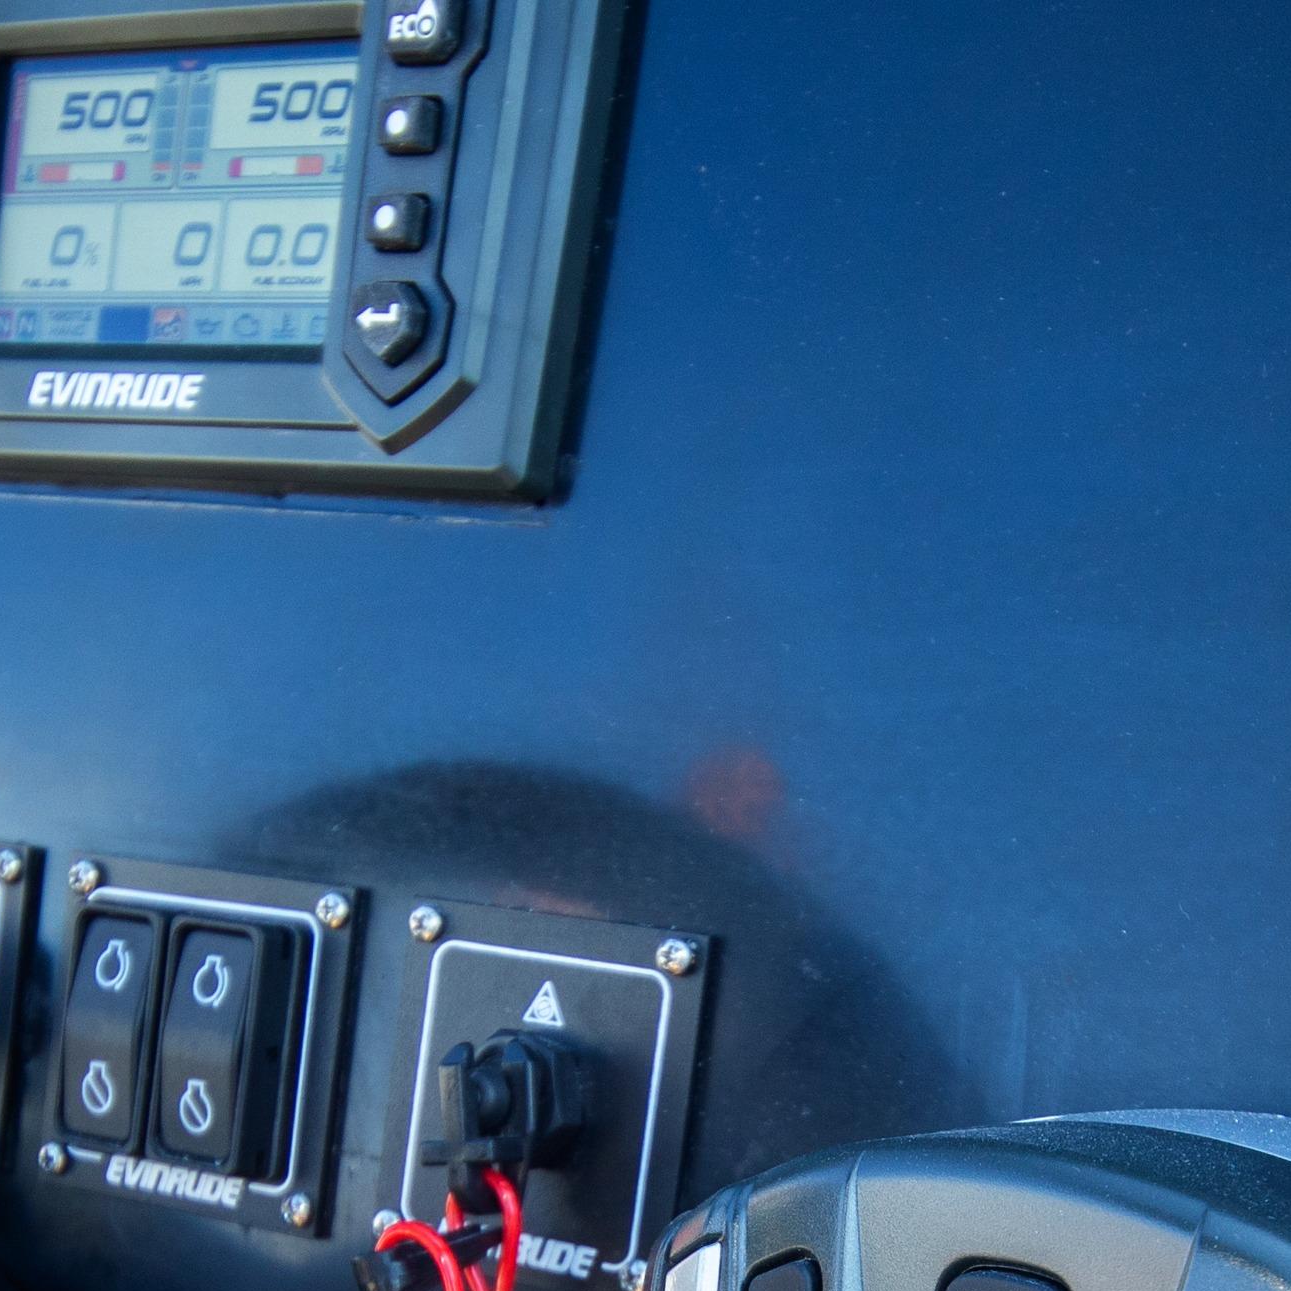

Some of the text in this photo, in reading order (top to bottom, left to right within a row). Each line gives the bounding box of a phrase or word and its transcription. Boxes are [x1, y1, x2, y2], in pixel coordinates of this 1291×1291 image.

[59, 88, 155, 131] 500
[248, 79, 354, 123] 500
[174, 222, 213, 266] 0
[245, 223, 330, 266] 0.0
[27, 371, 206, 409] EVINRUDE
[105, 1154, 245, 1208] EVINRUDE
